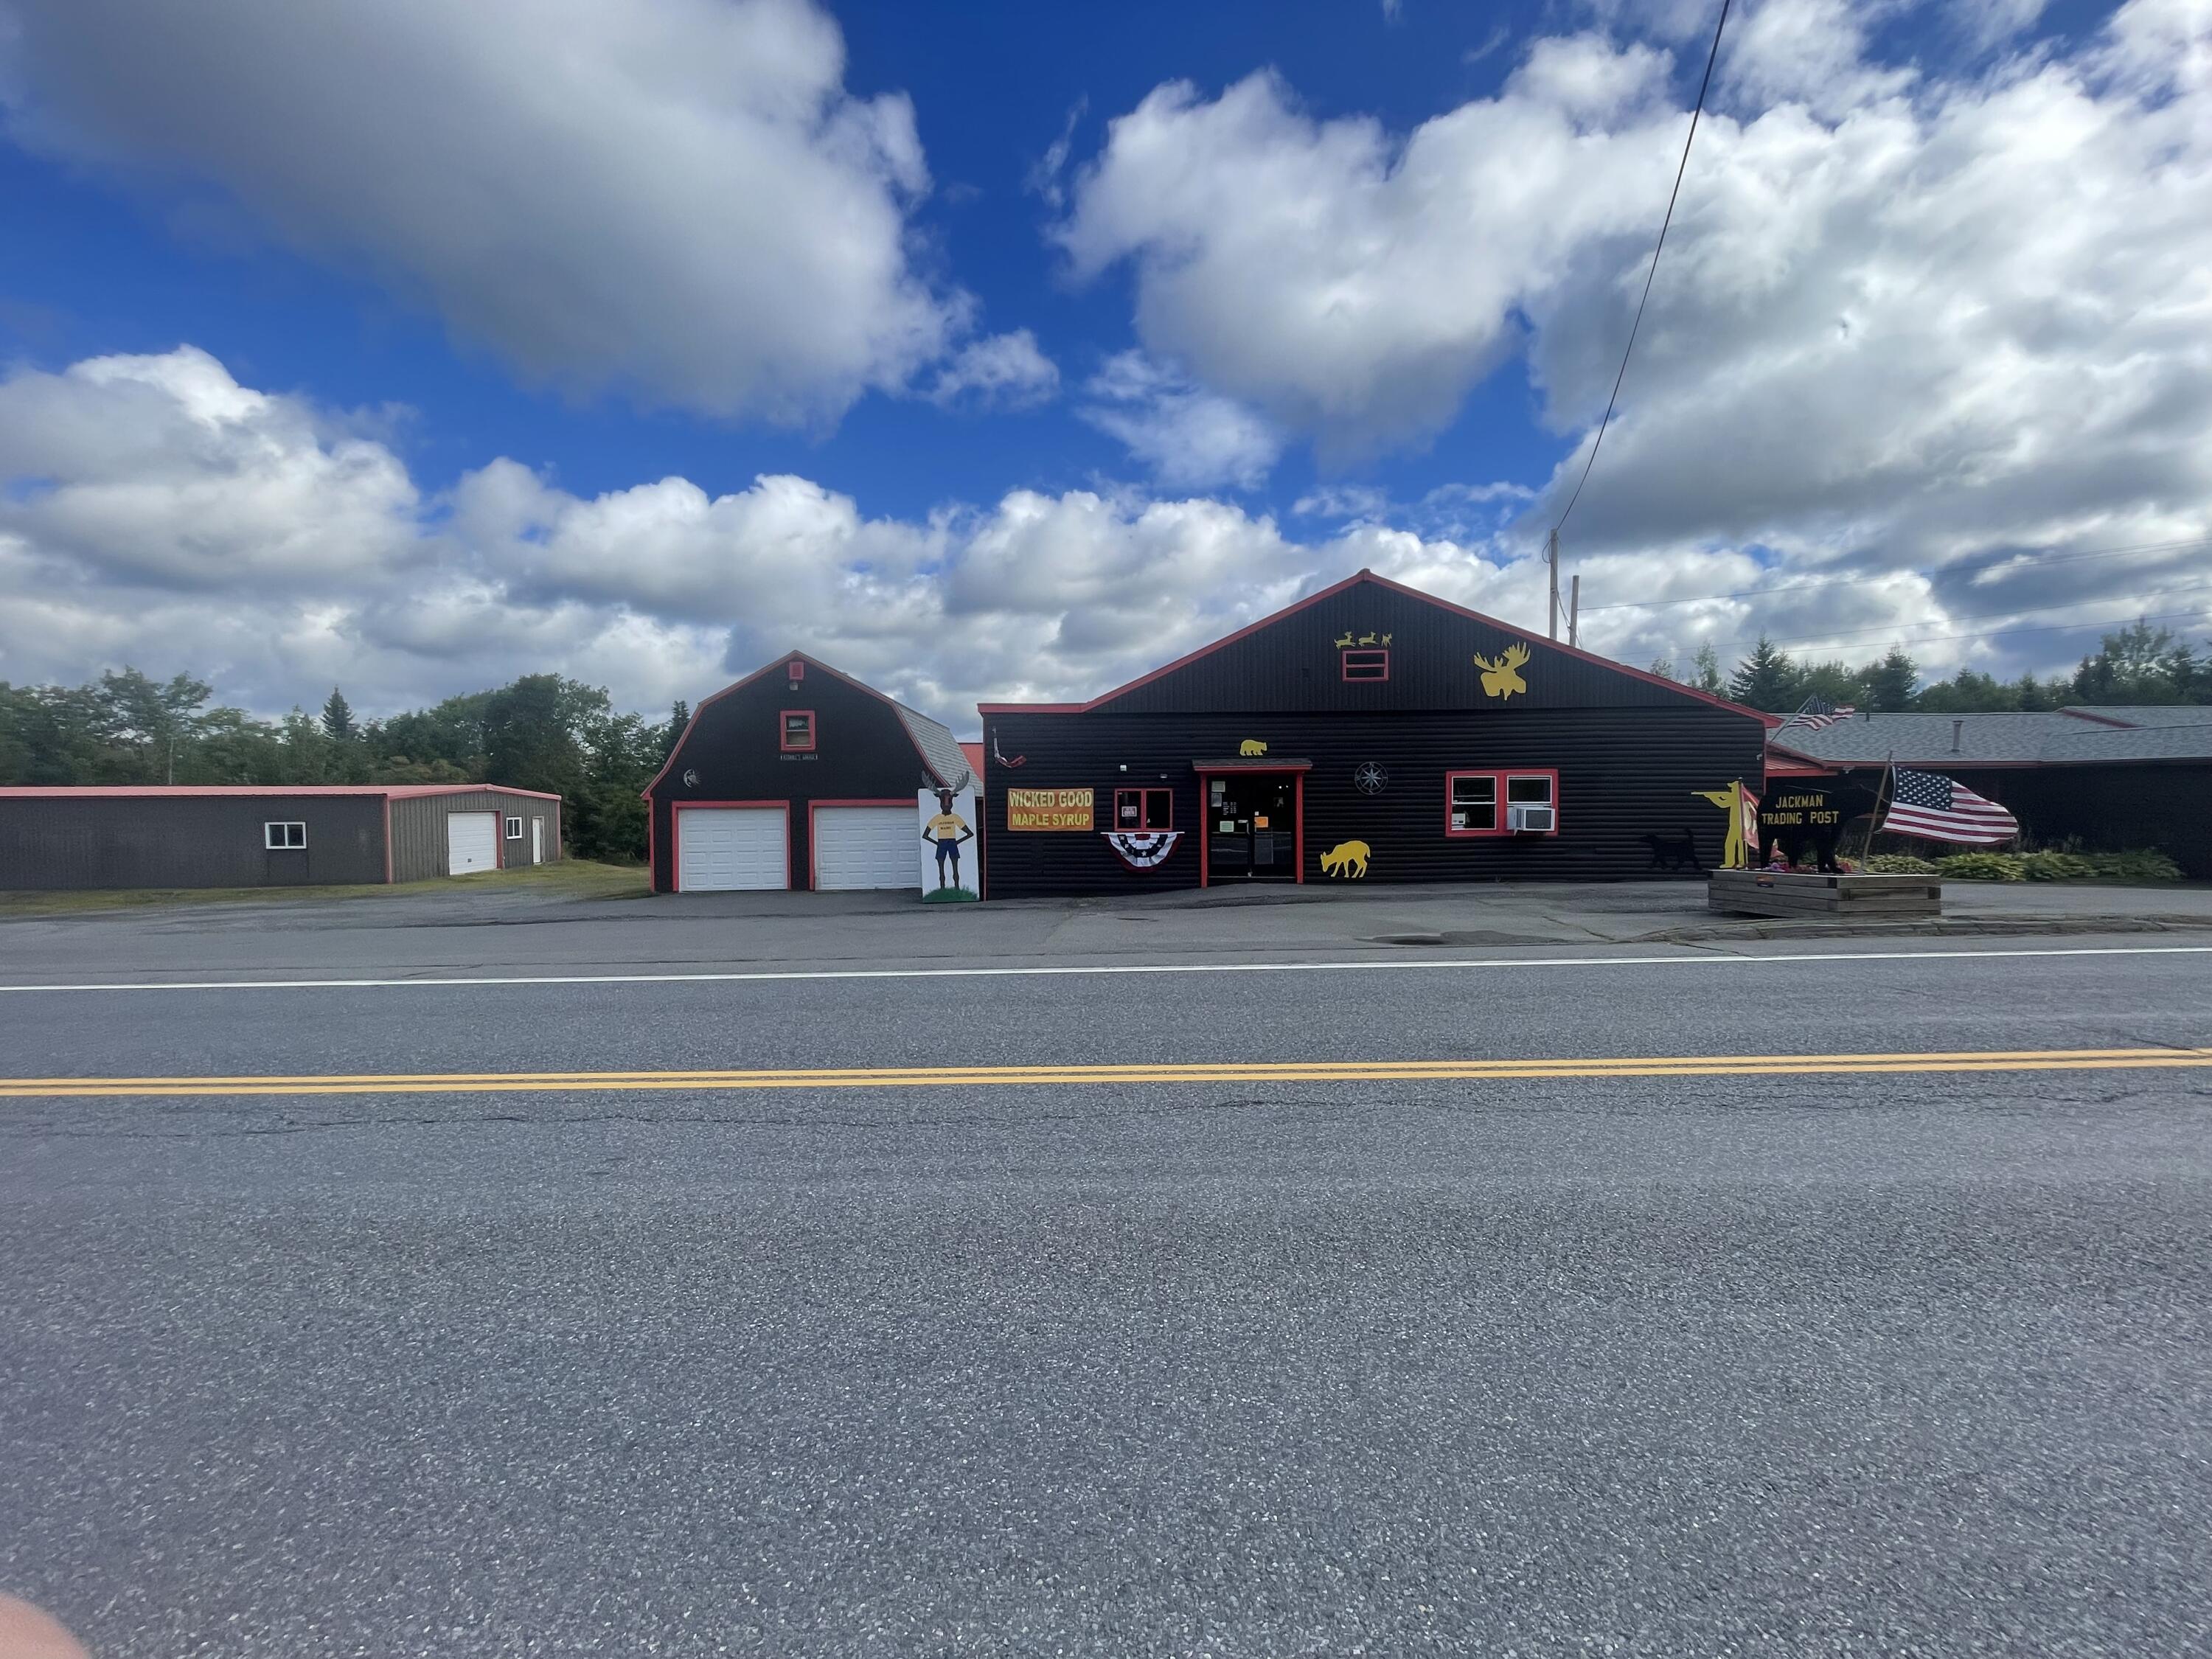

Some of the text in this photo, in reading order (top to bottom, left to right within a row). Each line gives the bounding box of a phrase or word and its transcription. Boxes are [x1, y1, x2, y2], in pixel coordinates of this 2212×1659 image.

[1009, 791, 1092, 807] WICKED GOOD
[1775, 795, 1823, 809] JACKMAN
[1012, 813, 1089, 826] MAPLE SYRUP
[1761, 811, 1839, 824] TRADING POST
